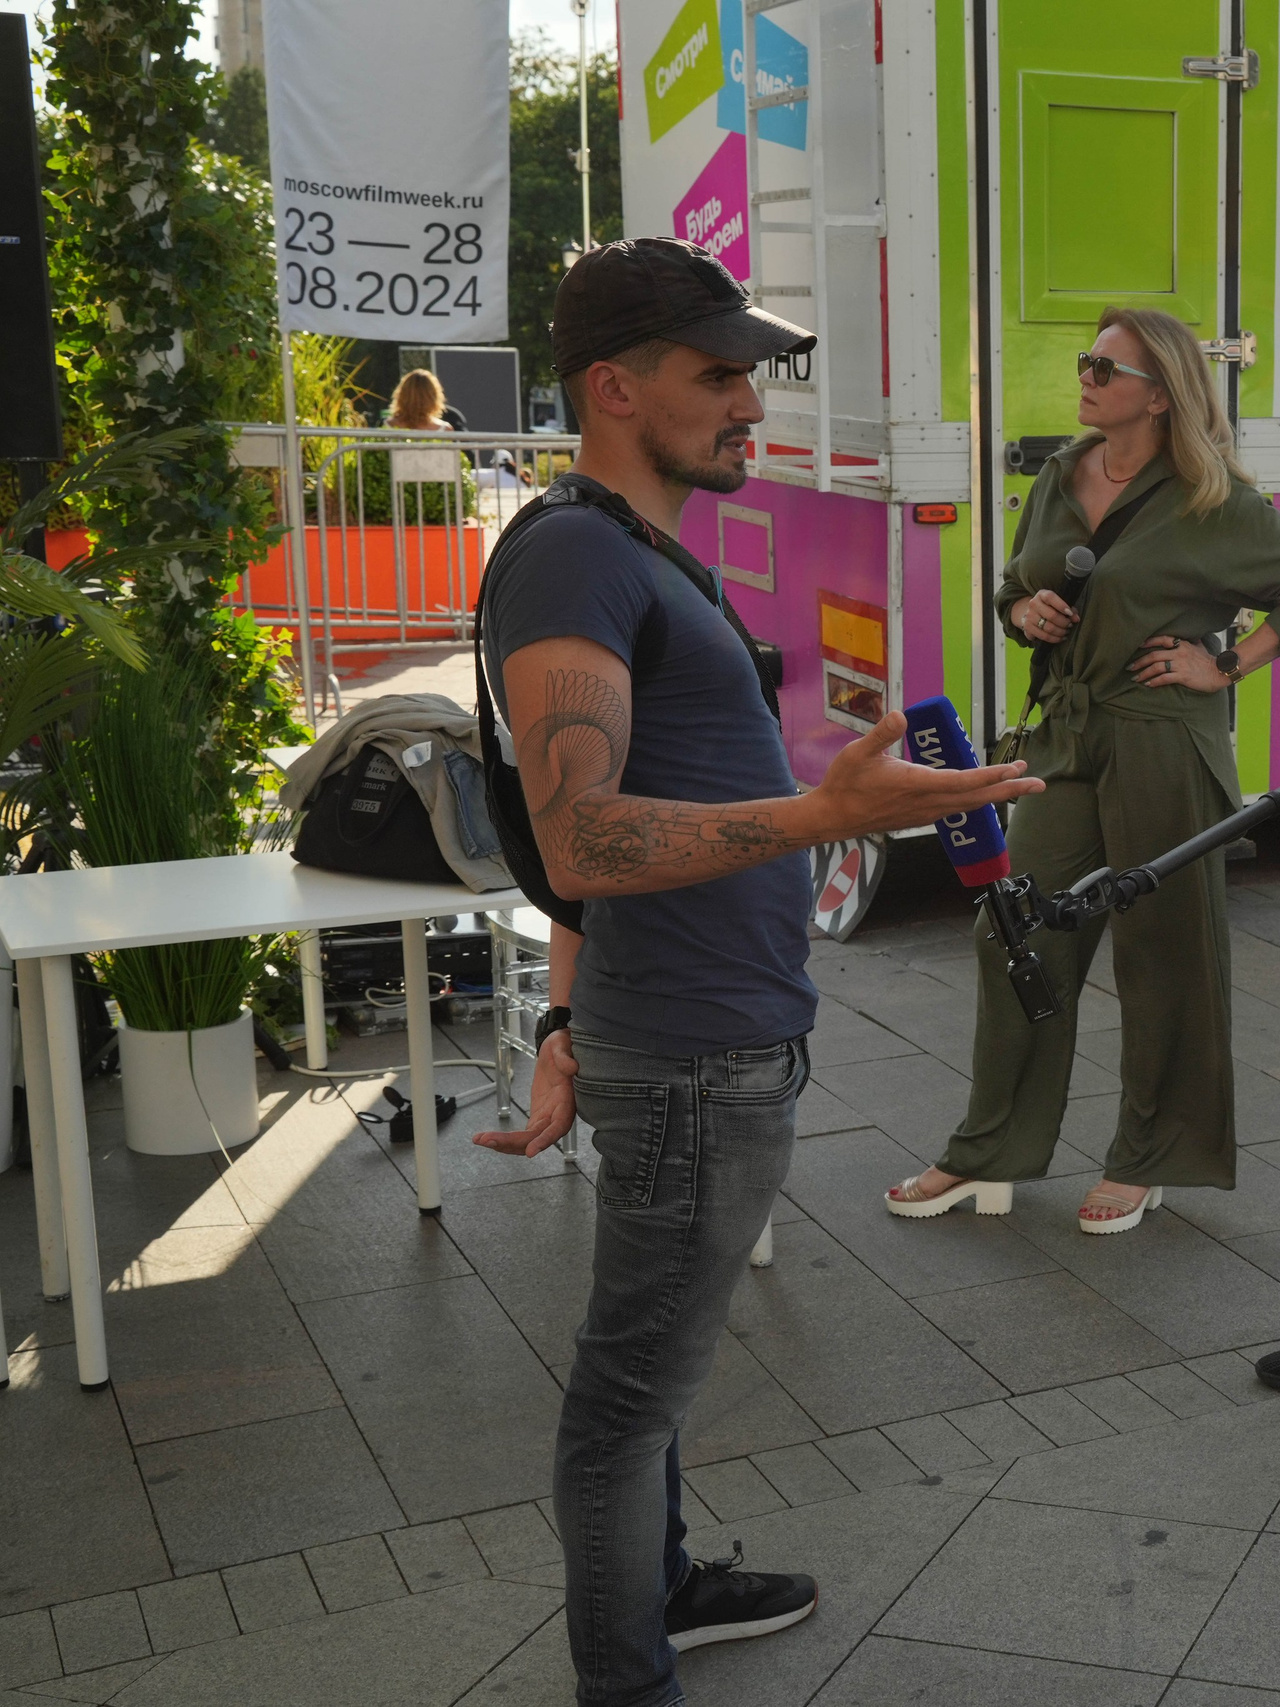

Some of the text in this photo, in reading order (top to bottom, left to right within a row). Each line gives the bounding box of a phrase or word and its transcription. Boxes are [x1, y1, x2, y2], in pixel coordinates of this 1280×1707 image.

[655, 21, 708, 99] Смотри
[284, 177, 483, 209] moscowfilmweek.ru
[685, 196, 722, 242] Будь
[284, 207, 335, 256] 23
[423, 222, 483, 265] 28
[286, 261, 482, 317] 08.2024
[914, 727, 977, 848] РОИЯ
